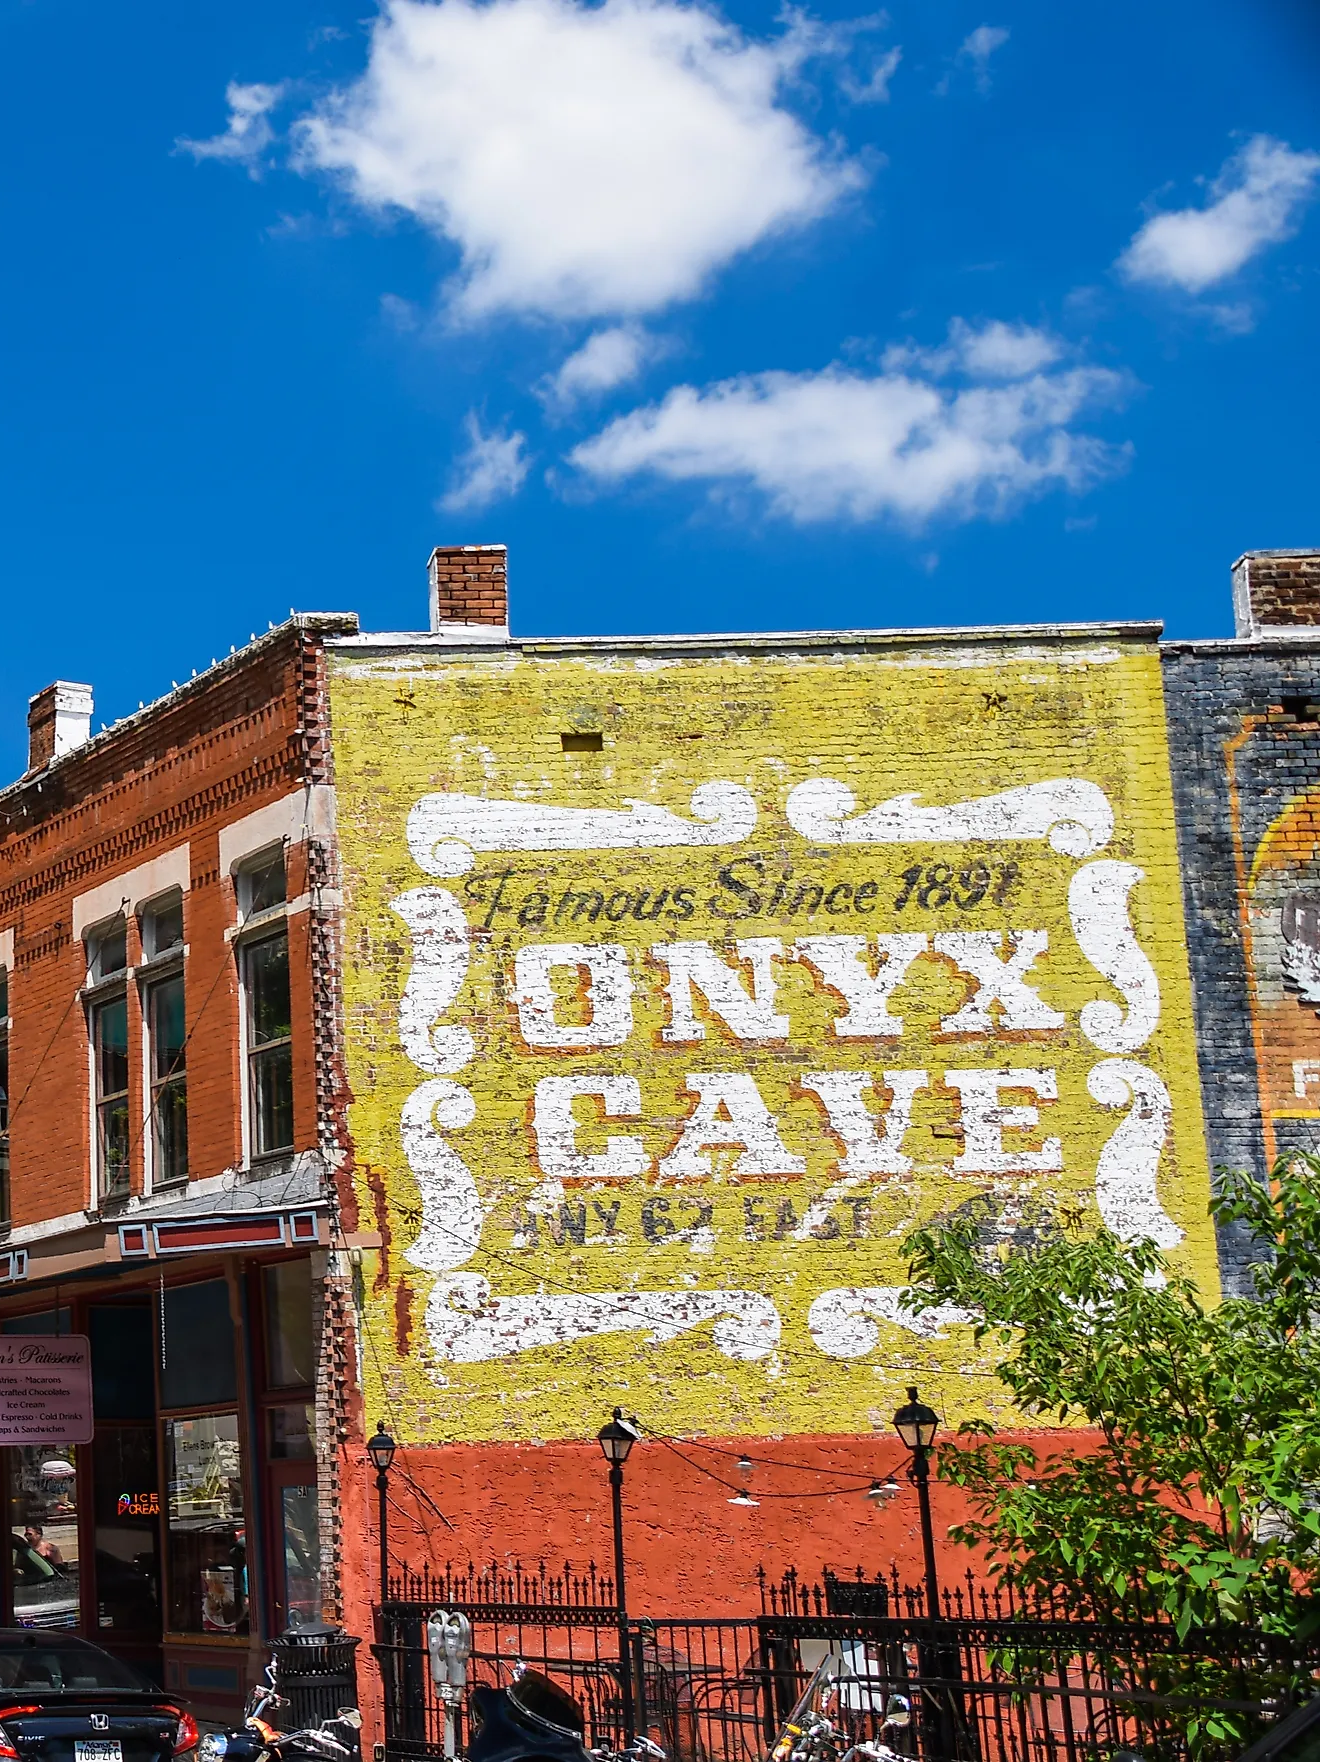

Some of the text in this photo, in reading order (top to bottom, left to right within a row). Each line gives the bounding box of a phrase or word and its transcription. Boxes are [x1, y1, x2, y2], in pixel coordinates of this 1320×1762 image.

[465, 869, 697, 928] Famous
[708, 856, 880, 922] Since
[510, 931, 1066, 1056] ONYX
[527, 1067, 1063, 1187] CAVE
[19, 1345, 84, 1364] Patisserie
[25, 1376, 61, 1384] Macarons
[29, 1388, 70, 1396] Chocolates
[1, 1413, 34, 1422] Espresso
[21, 1425, 66, 1433] Sandwiches
[134, 1493, 159, 1503] ICE
